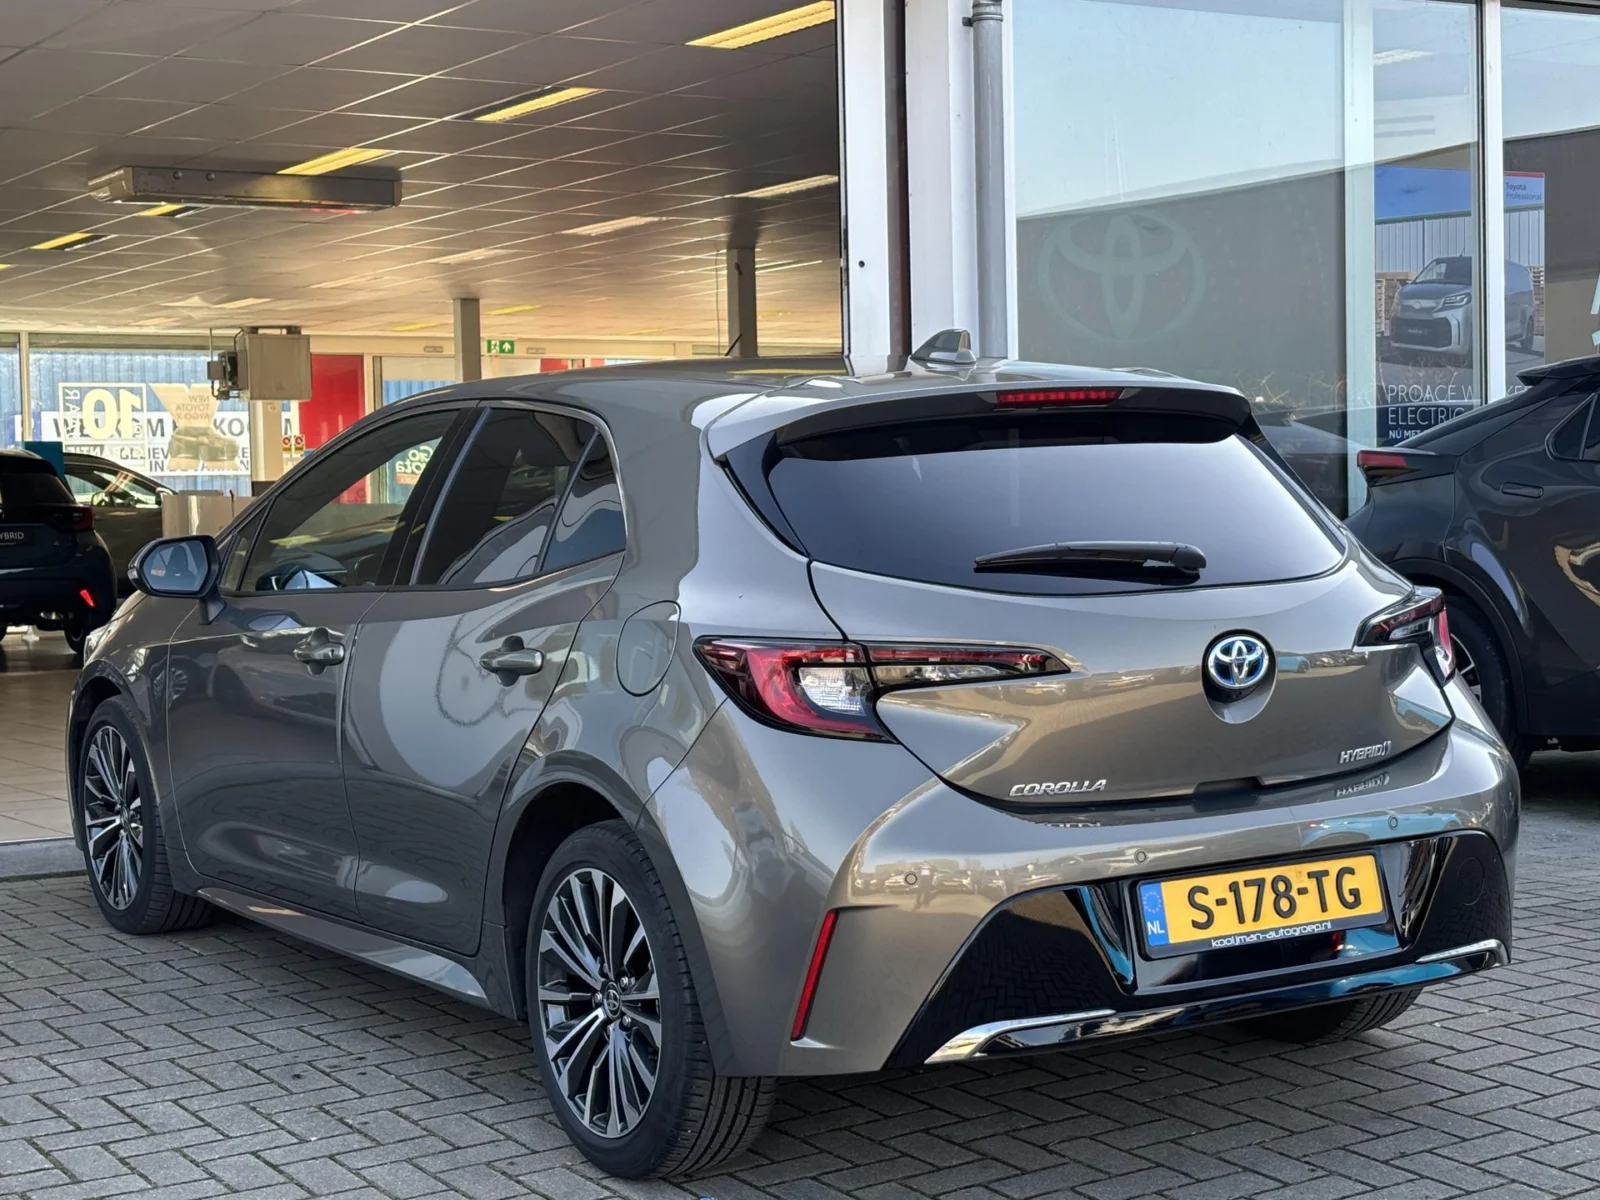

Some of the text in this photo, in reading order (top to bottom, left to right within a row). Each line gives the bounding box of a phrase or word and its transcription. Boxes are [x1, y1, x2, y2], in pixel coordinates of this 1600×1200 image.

[1505, 182, 1527, 191] Toyota
[1387, 384, 1456, 402] PROACE
[149, 460, 165, 472] IN
[1339, 744, 1383, 764] HYBRID
[1008, 779, 1107, 797] COROLLA
[1187, 866, 1363, 931] S-178-TG
[1147, 921, 1165, 936] NL
[1211, 920, 1332, 949] kooijman-autogroep.nl
